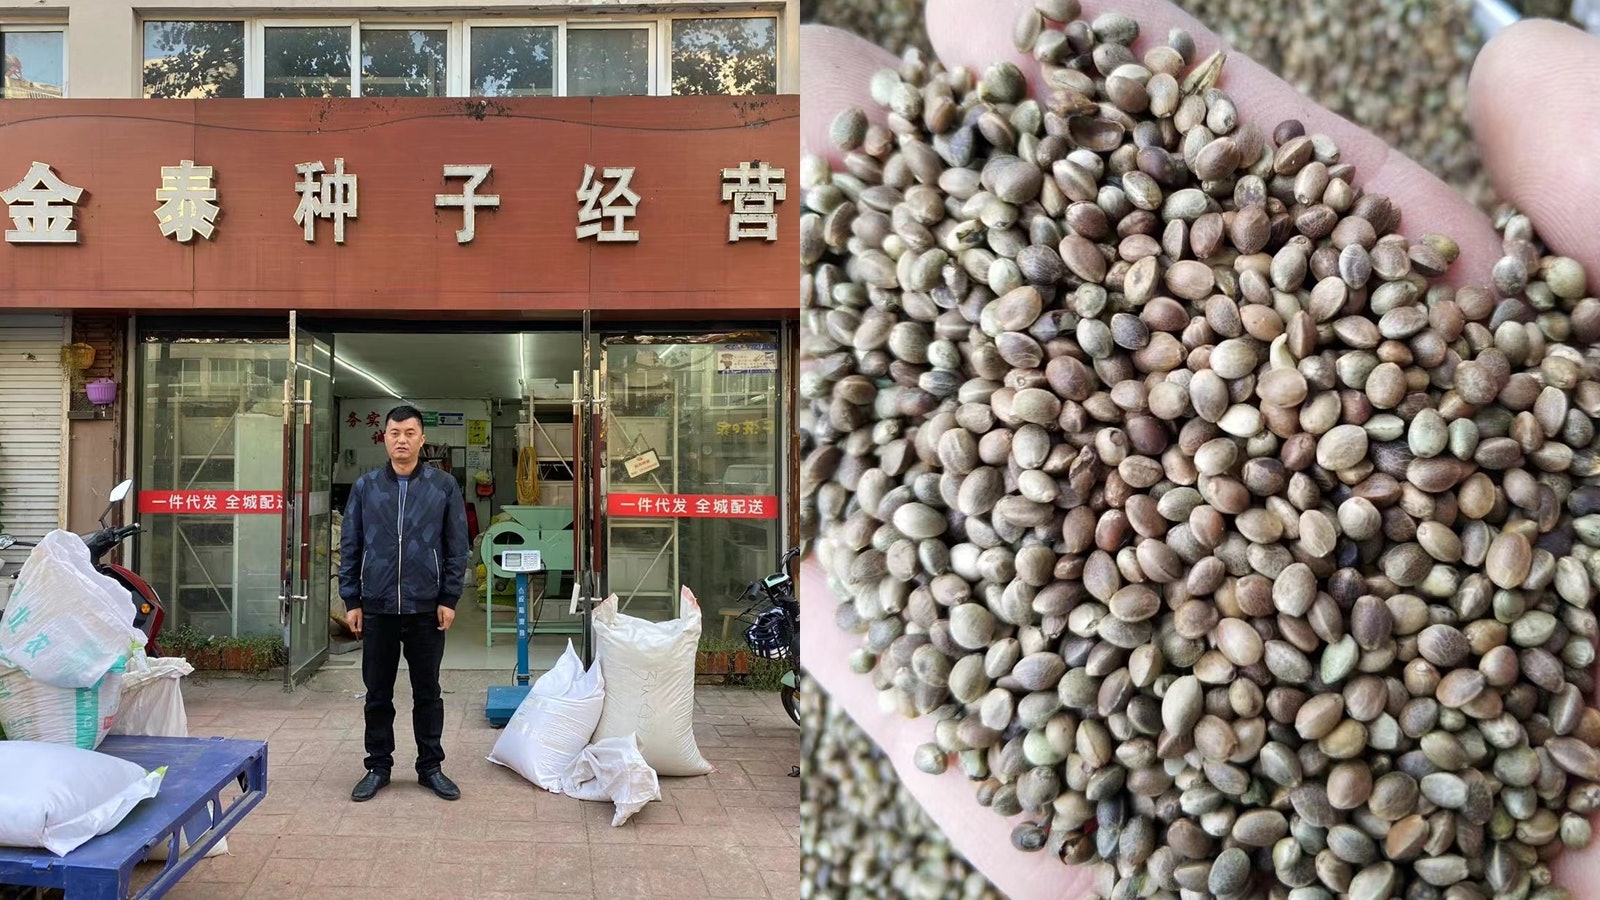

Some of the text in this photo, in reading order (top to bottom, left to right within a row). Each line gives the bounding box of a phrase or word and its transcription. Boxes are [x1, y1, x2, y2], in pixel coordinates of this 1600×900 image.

[0, 158, 787, 244] 金泰种子经营
[345, 411, 380, 428] 务实
[152, 494, 217, 510] 一件代发
[620, 497, 764, 515] 一件代发 全城配送
